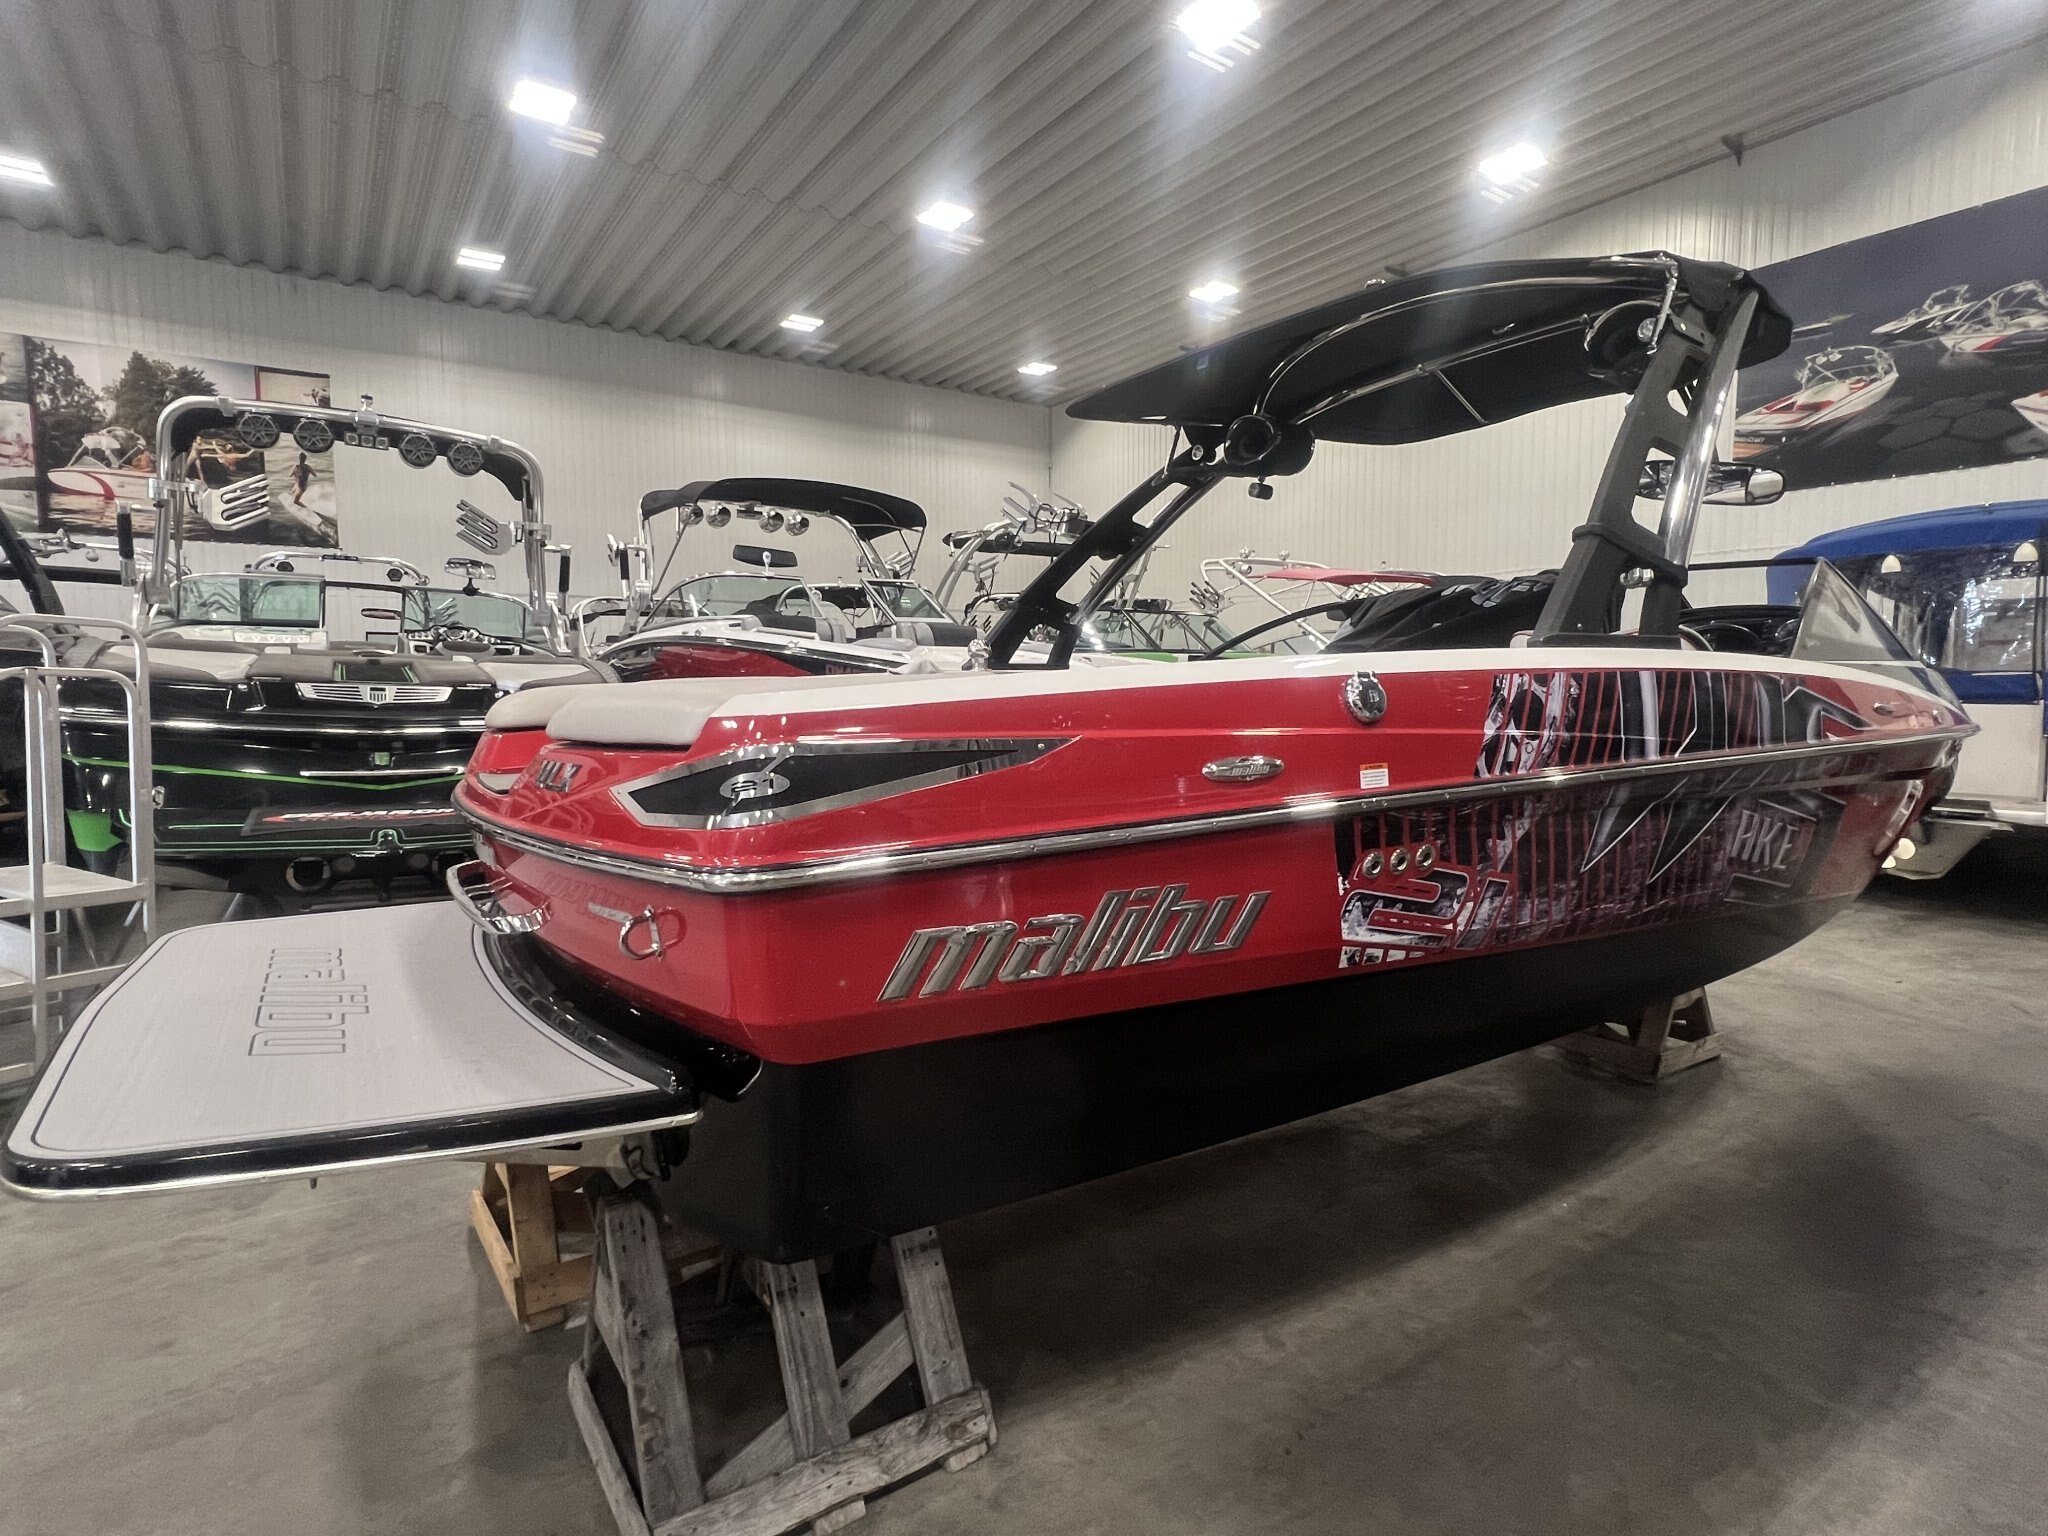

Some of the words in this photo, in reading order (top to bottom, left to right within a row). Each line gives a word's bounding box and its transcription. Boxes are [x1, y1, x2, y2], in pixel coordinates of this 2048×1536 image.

[1231, 764, 1270, 777] malibu
[876, 883, 1273, 1002] malibu
[247, 947, 370, 1056] malibu
